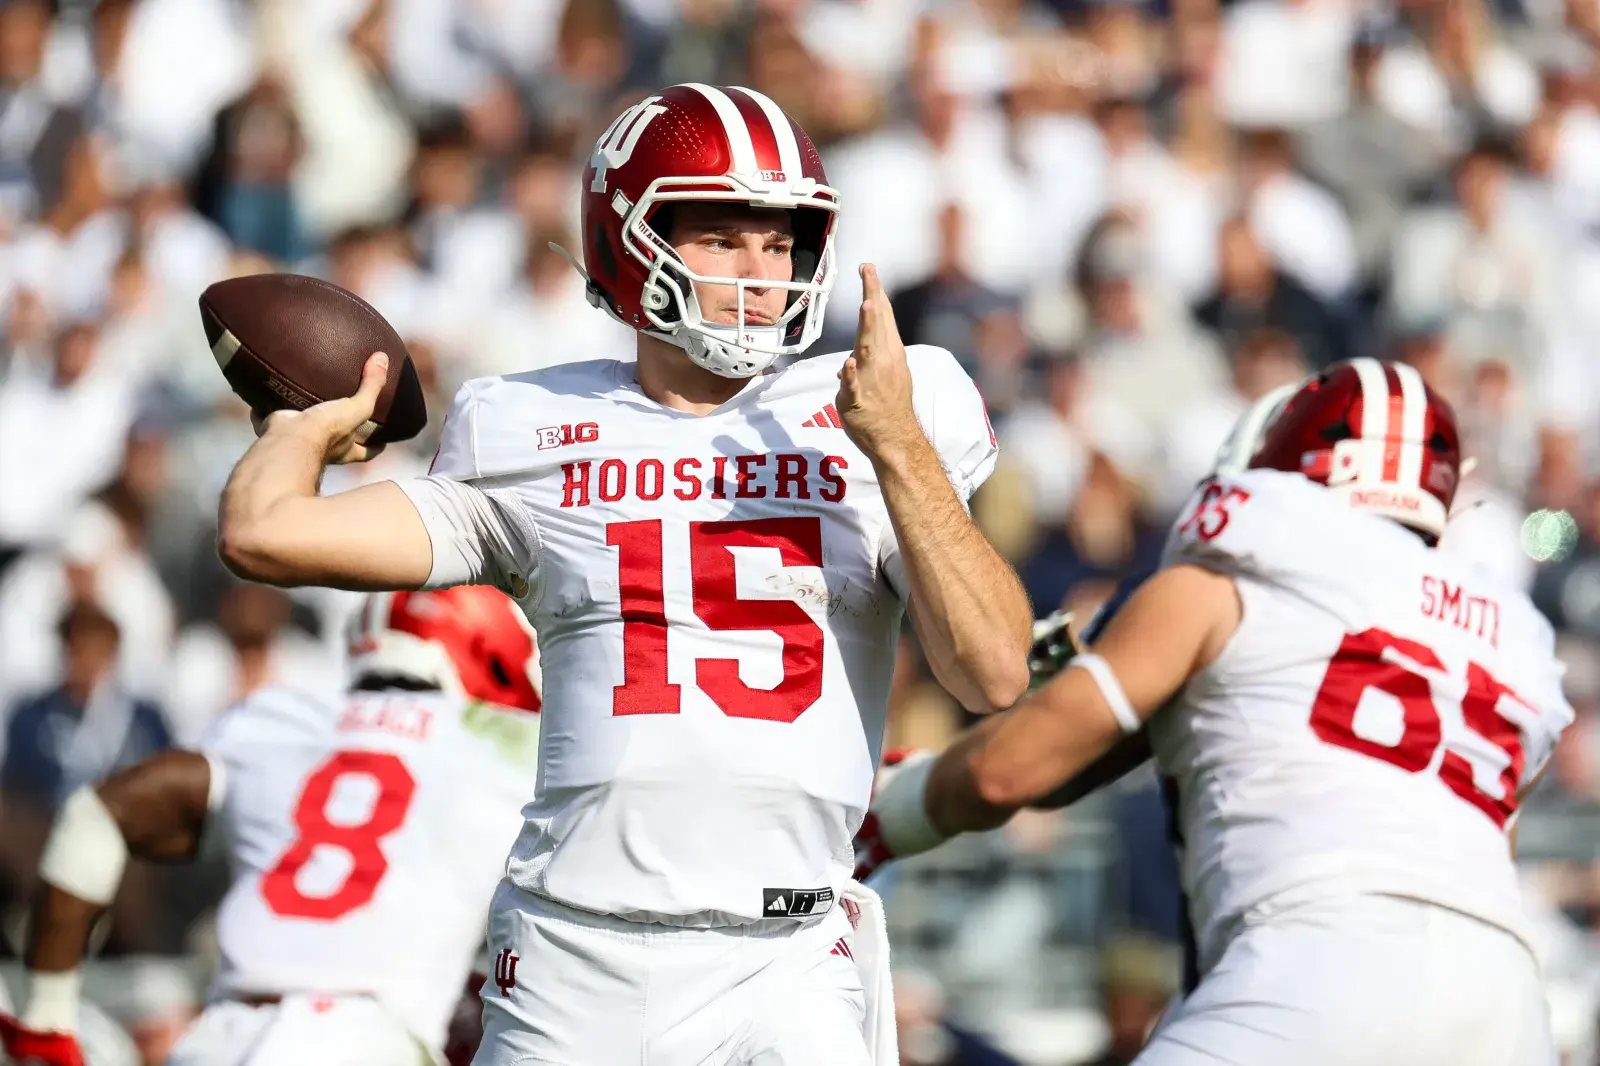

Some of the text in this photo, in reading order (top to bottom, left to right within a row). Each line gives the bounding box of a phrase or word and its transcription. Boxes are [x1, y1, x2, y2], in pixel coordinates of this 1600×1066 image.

[560, 453, 849, 508] HOOSIERS
[606, 516, 824, 724] 15
[1309, 626, 1541, 832] 65
[259, 748, 417, 923] 8
